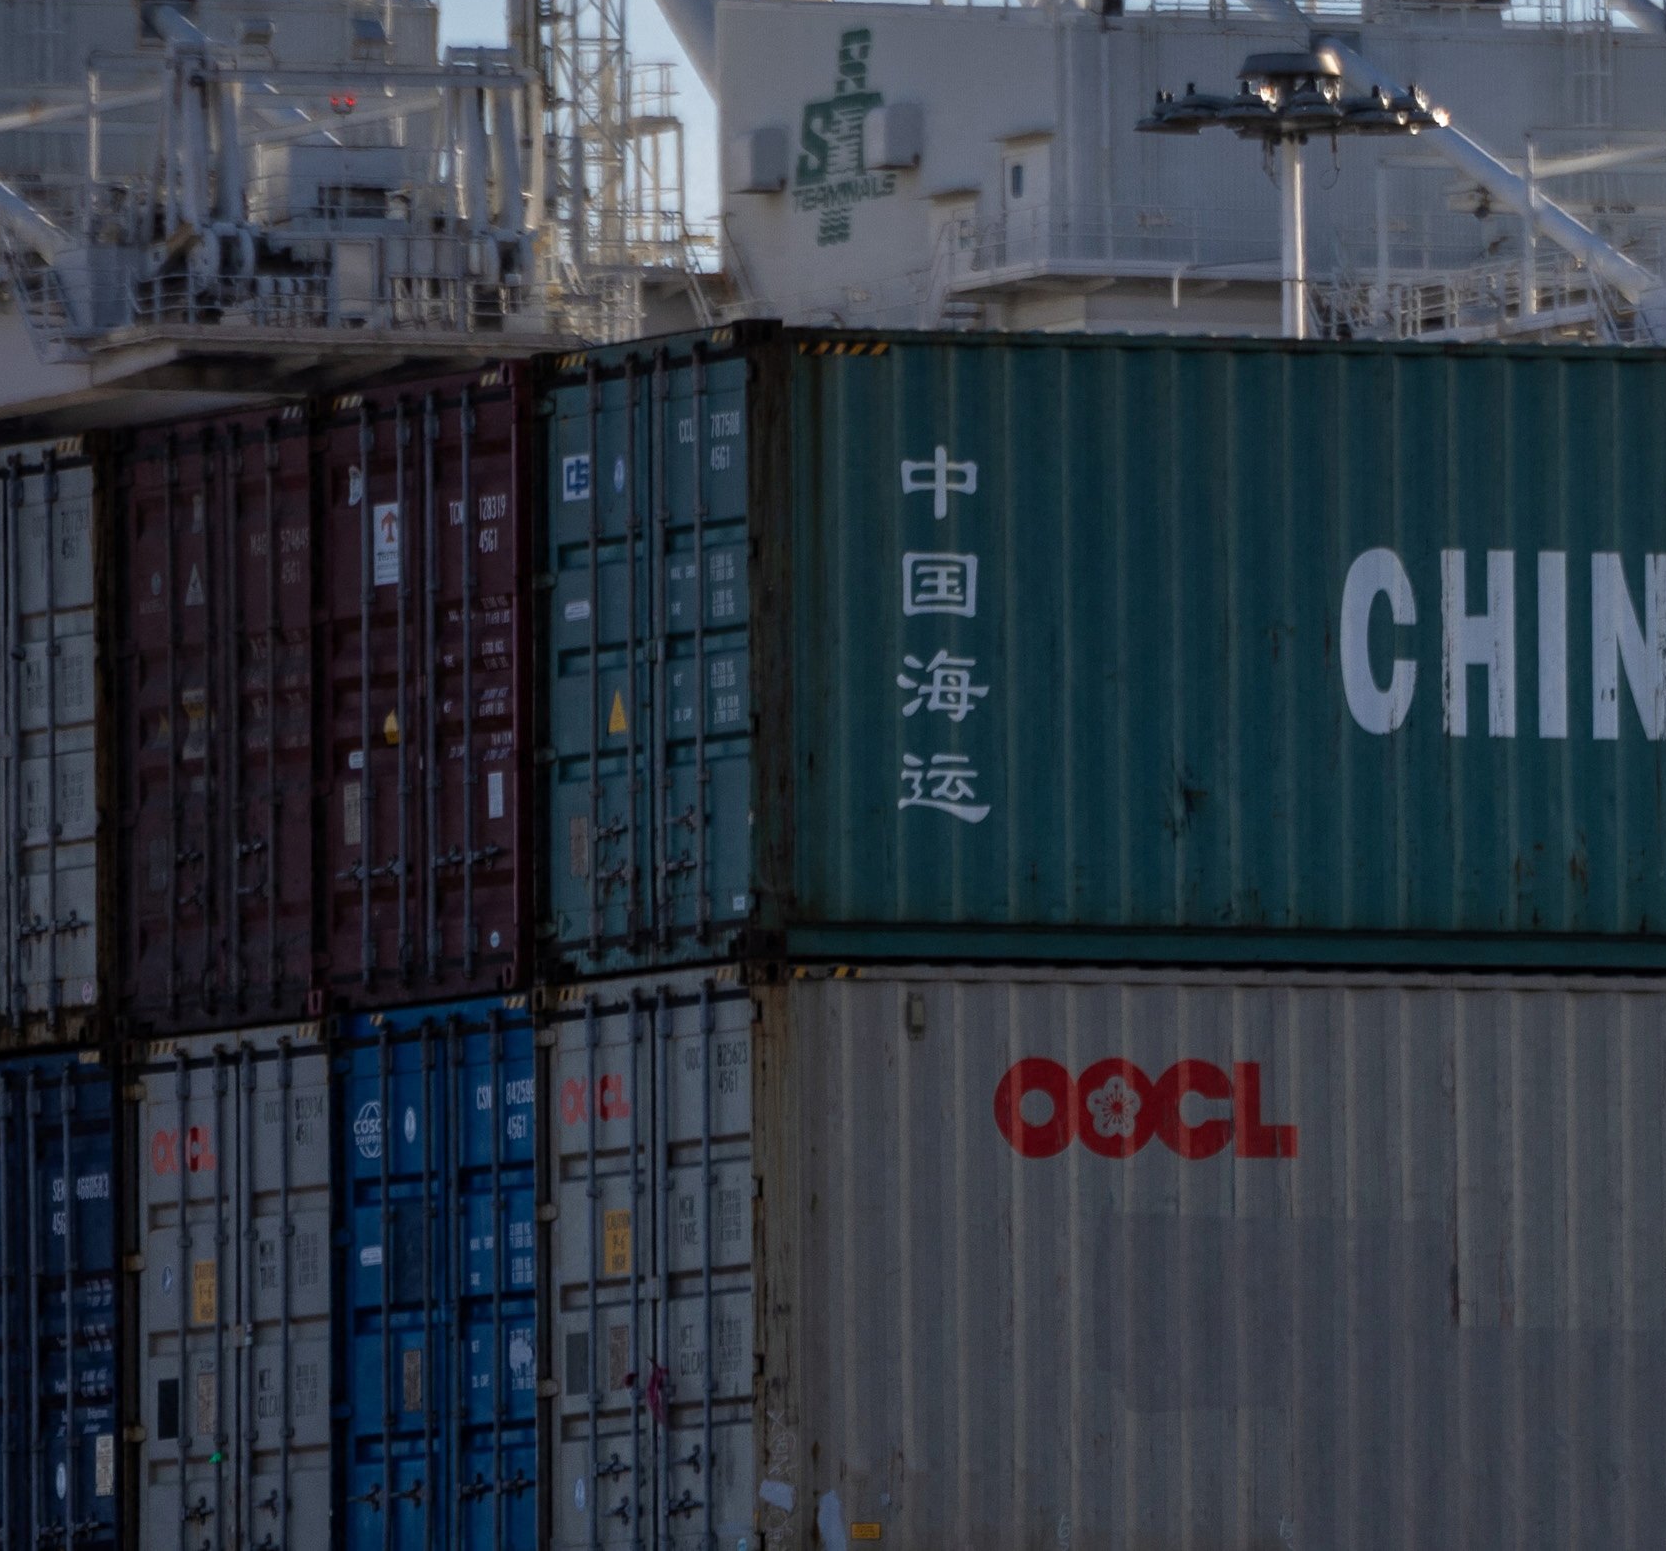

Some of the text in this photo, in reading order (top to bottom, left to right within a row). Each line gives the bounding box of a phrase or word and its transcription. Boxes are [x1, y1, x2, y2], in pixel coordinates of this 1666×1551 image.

[678, 418, 694, 444] CCL
[895, 444, 992, 824] 中国海运
[993, 1057, 1299, 1160] OOCL
[353, 1117, 382, 1135] COSC
[354, 1135, 382, 1147] SHIPPI
